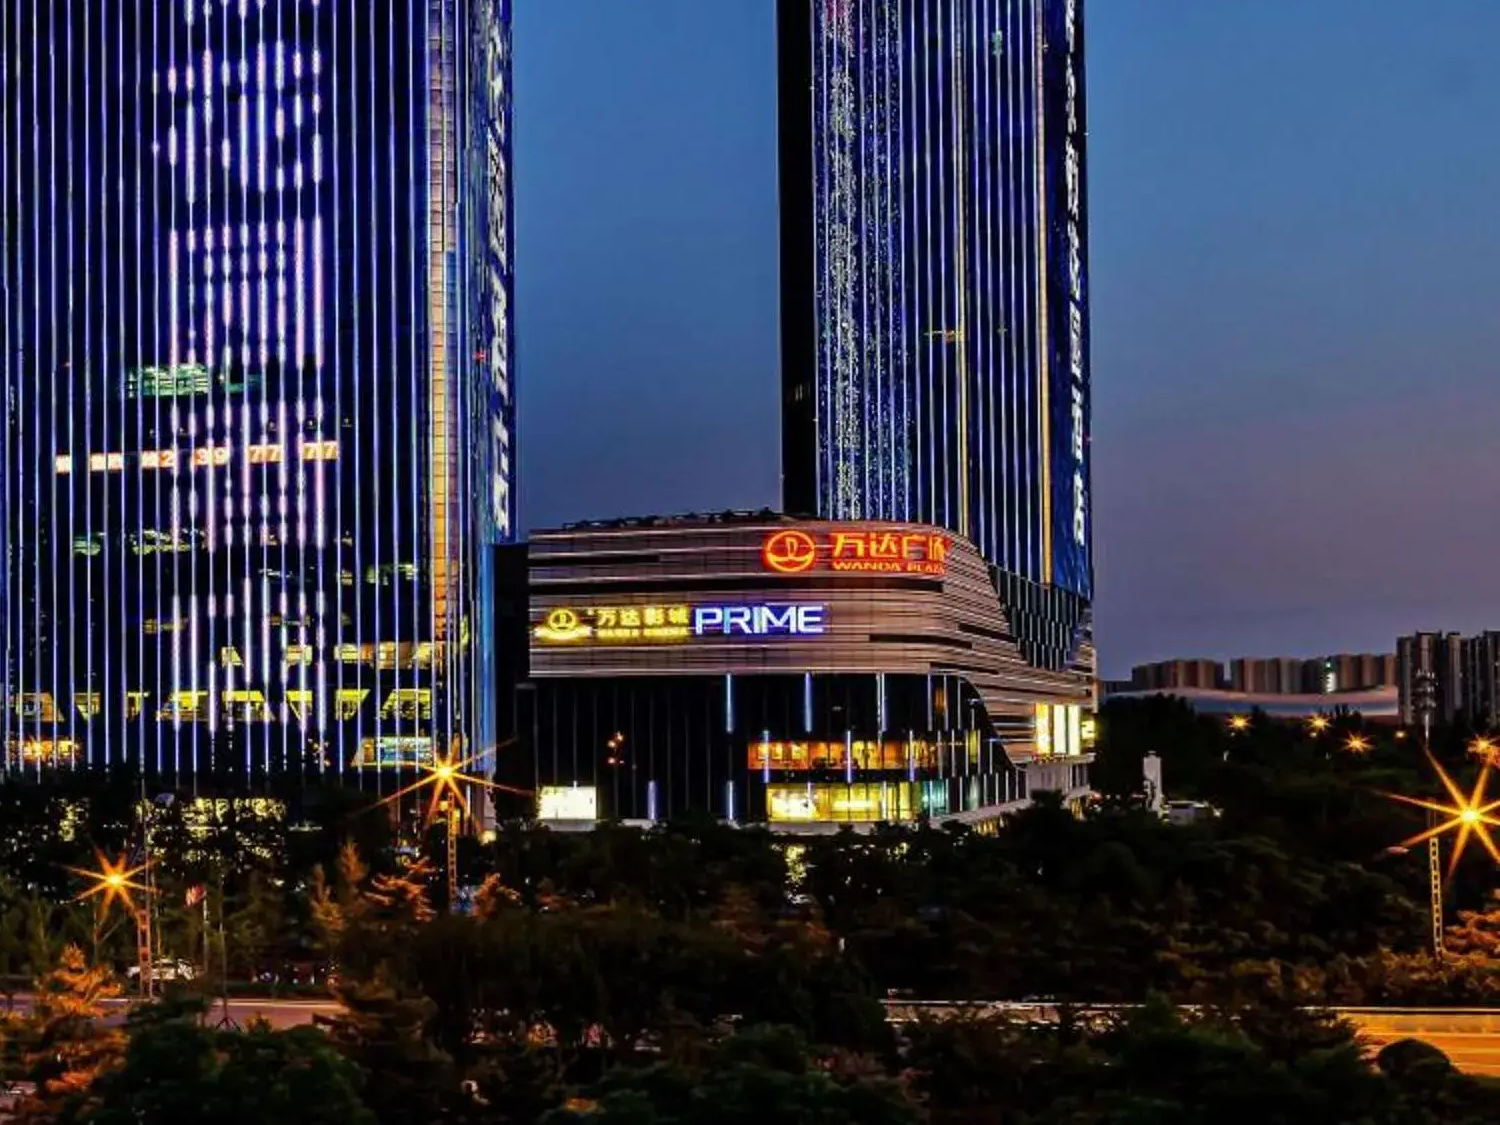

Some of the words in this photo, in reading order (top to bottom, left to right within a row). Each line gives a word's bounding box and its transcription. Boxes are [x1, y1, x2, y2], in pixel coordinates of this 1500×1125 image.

[833, 530, 946, 562] 万达广场
[833, 561, 901, 572] WANDA
[695, 607, 824, 634] PRIME
